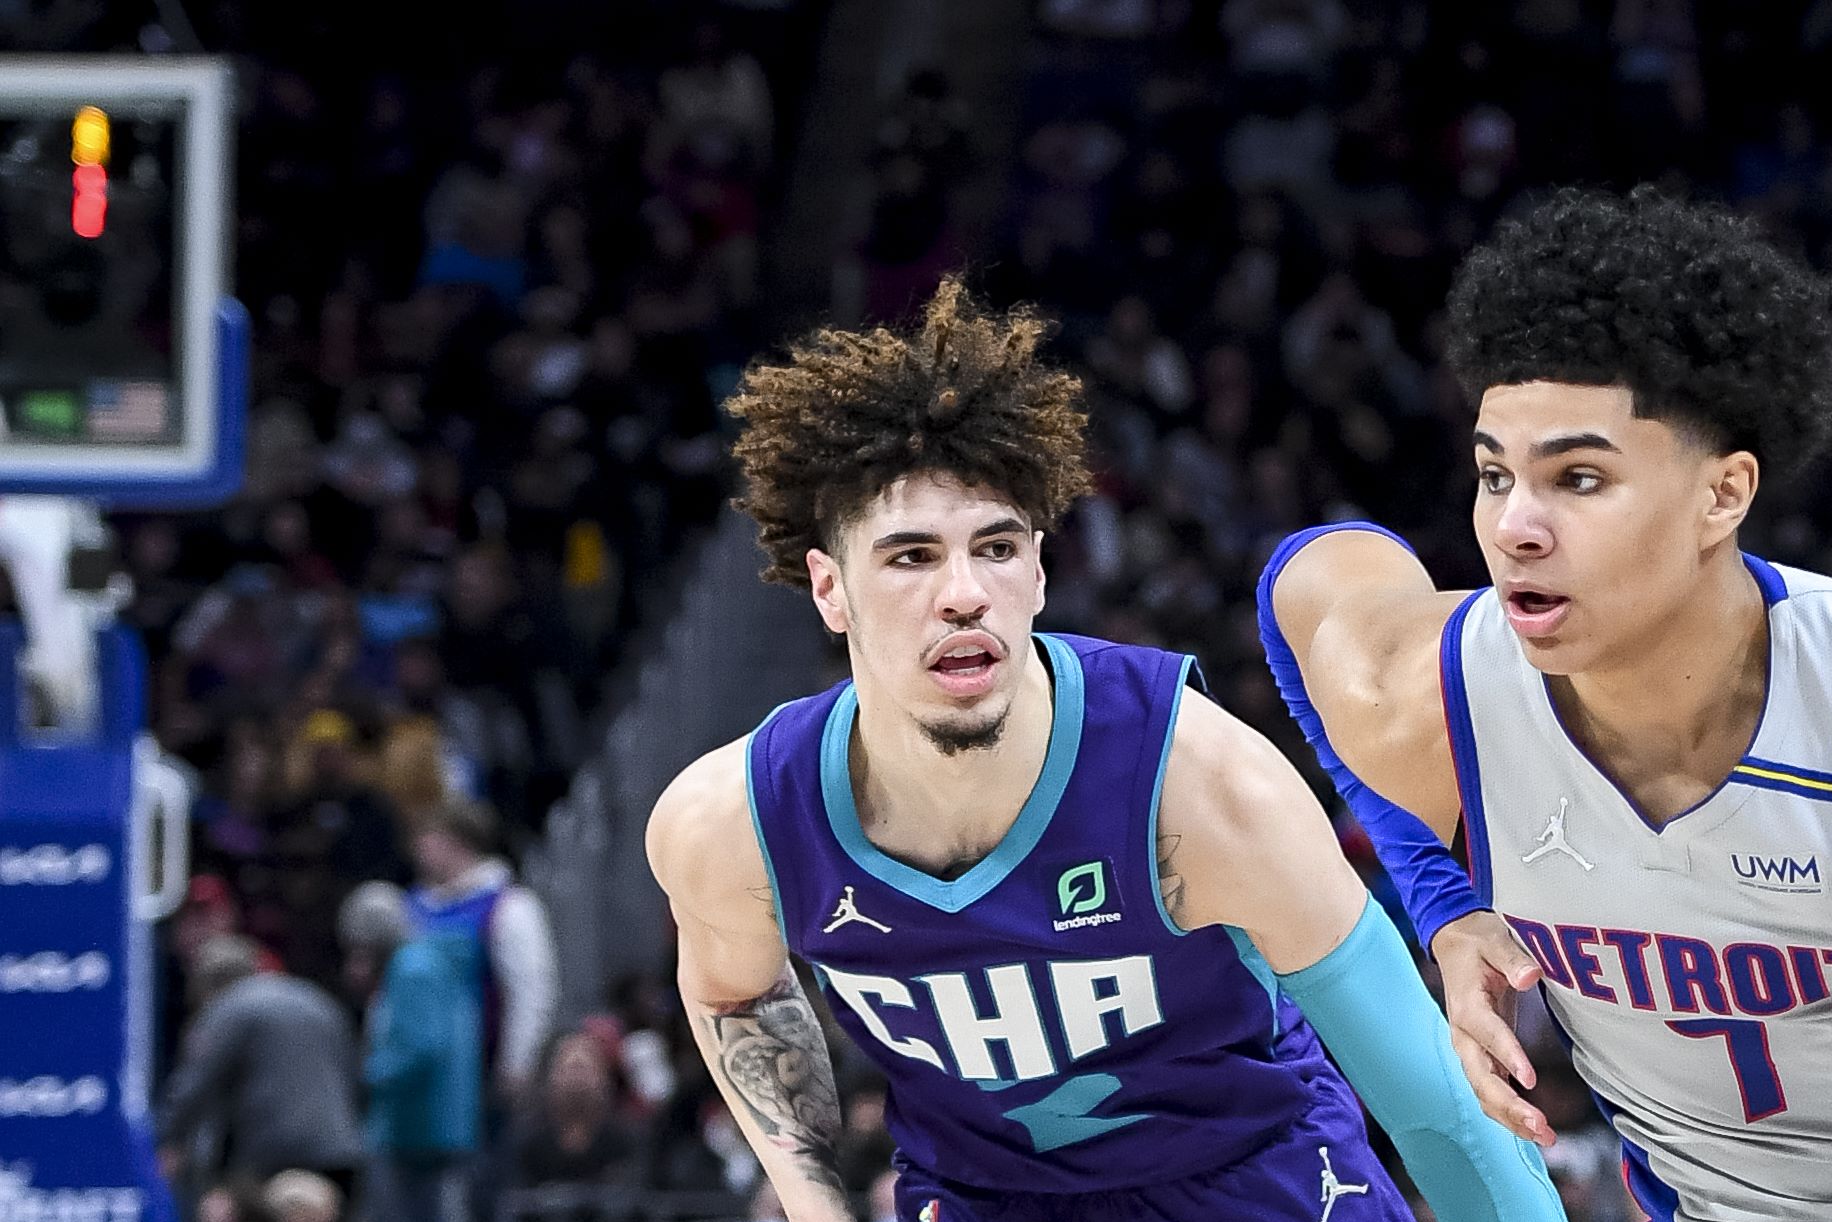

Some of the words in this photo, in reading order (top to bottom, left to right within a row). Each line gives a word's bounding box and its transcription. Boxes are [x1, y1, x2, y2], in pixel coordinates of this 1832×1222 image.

[1731, 854, 1820, 883] UWM
[1053, 912, 1122, 932] lendingtree
[813, 955, 1165, 1082] CHA
[1664, 1017, 1787, 1124] 7
